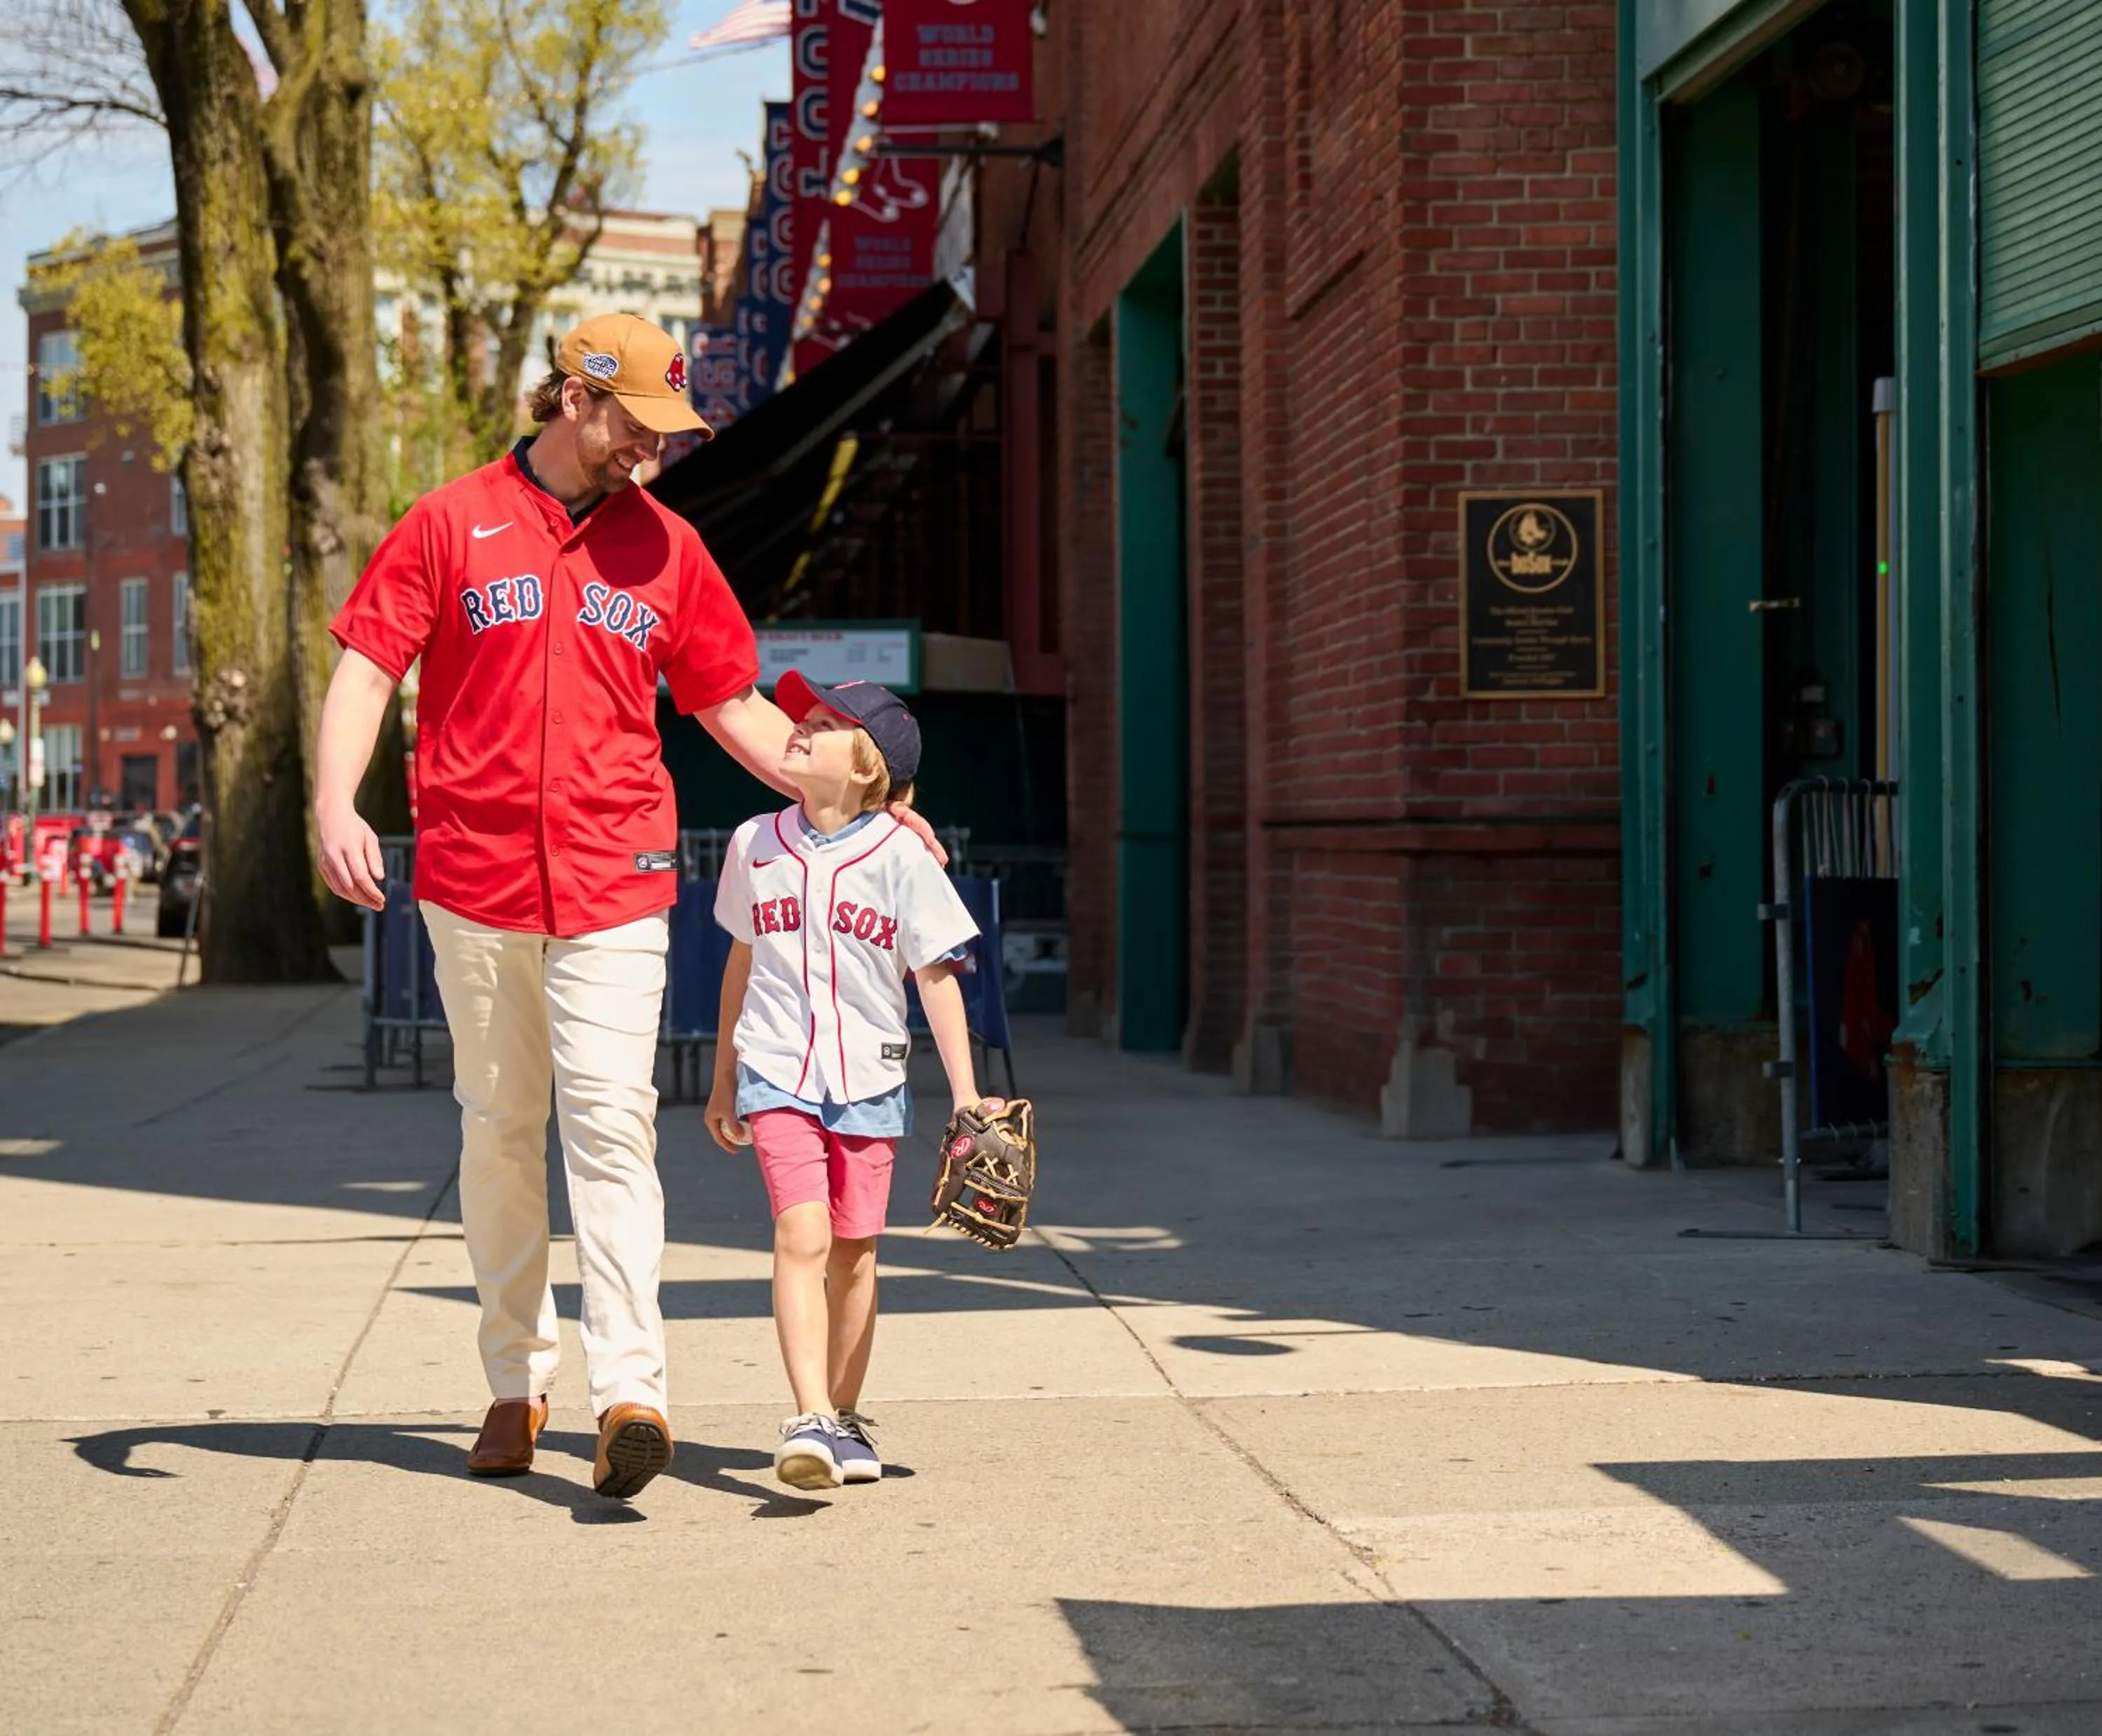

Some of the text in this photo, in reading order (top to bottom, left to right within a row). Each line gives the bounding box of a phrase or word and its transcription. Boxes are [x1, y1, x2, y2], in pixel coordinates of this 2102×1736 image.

[460, 574, 659, 651] RED SOX
[832, 901, 898, 950] SOX
